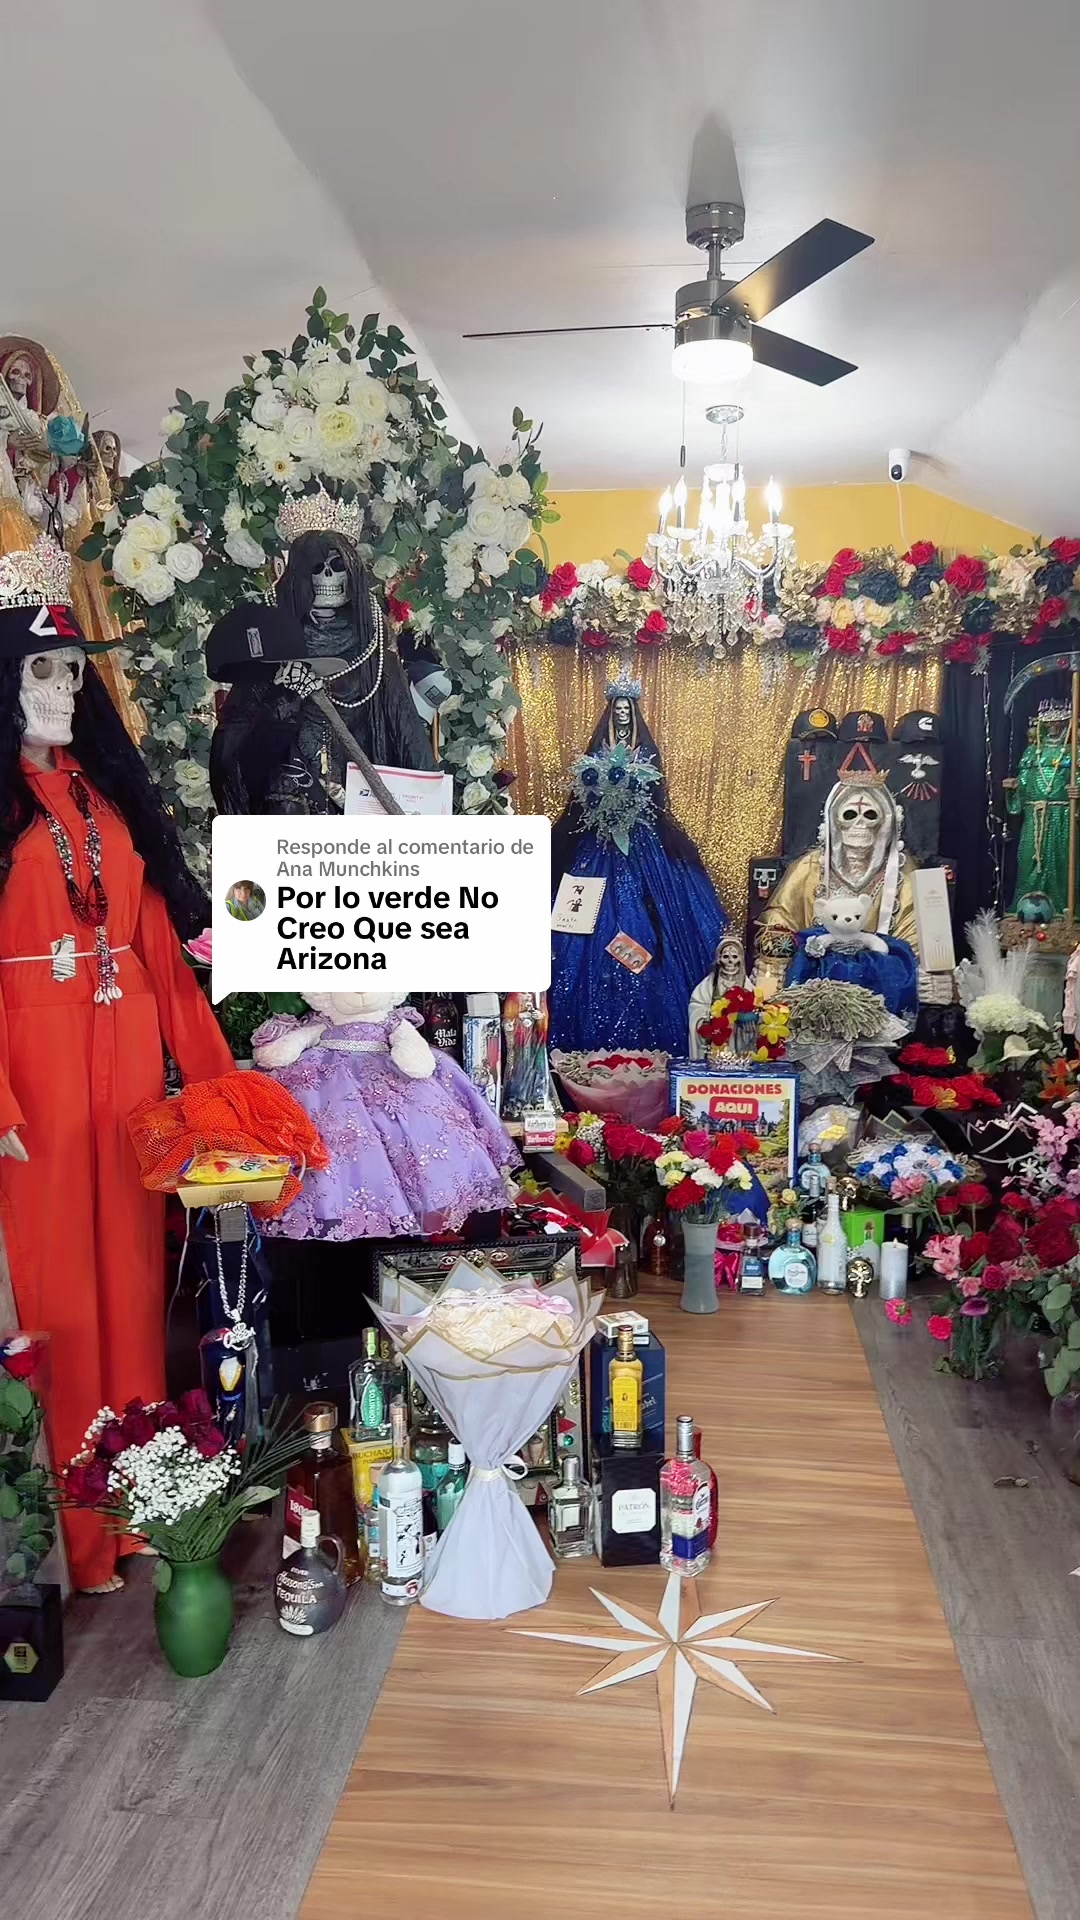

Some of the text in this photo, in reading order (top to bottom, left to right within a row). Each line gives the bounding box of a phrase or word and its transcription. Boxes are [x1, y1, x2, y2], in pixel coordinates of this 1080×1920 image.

[433, 1028, 457, 1039] Mala
[436, 1037, 457, 1047] Vida
[687, 1084, 782, 1095] DONACIONES
[714, 1101, 753, 1114] AQUI
[368, 1388, 376, 1426] HORNITOS
[618, 1501, 650, 1512] PATRÓN
[276, 1586, 318, 1604] TEQUILA
